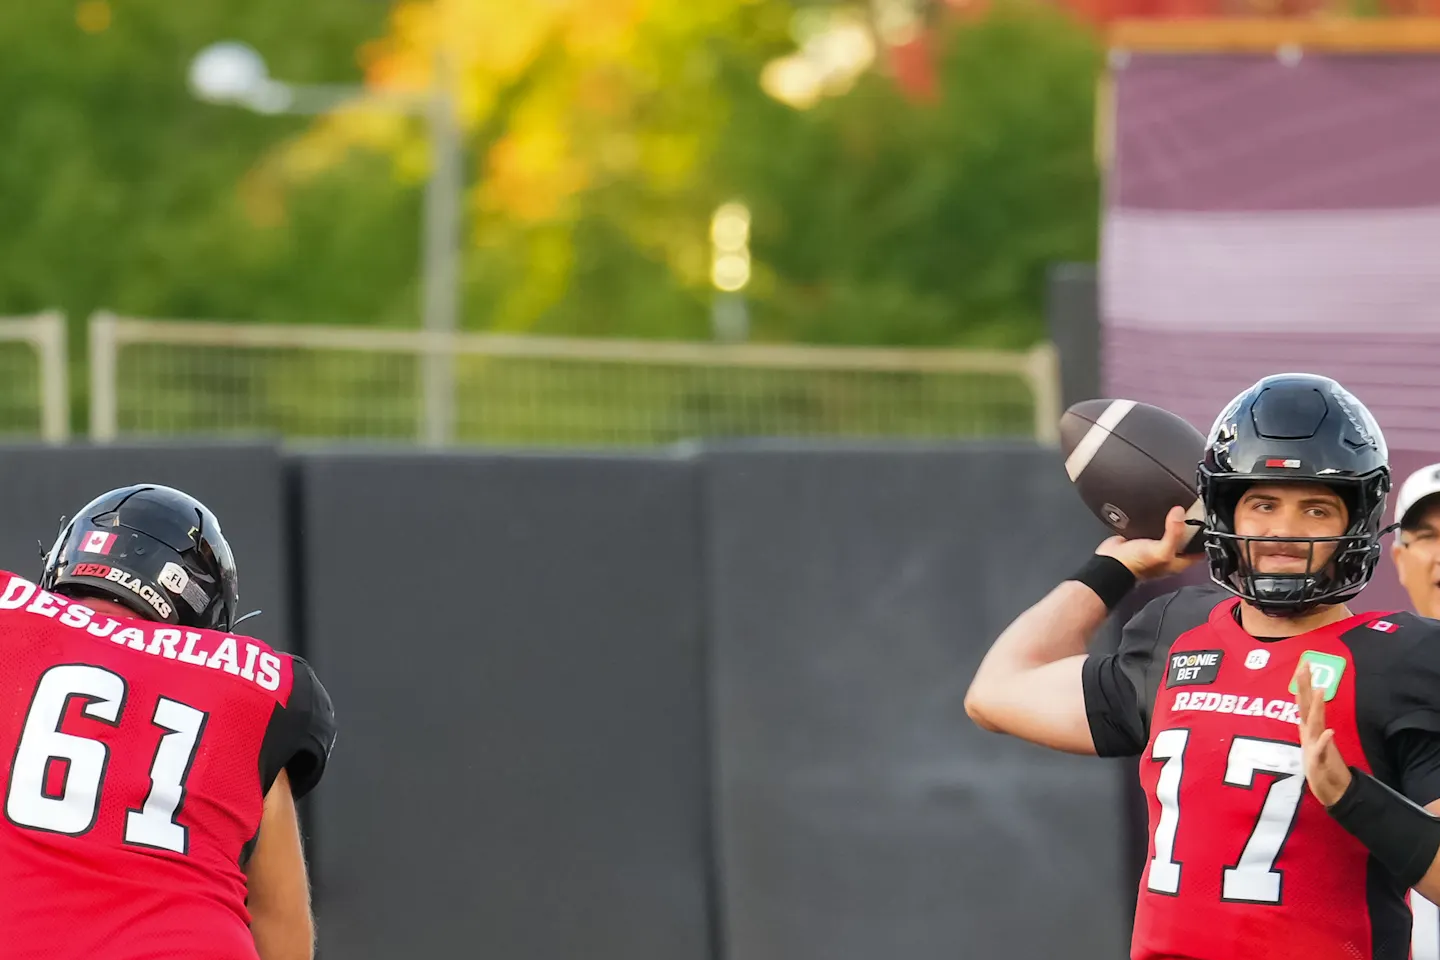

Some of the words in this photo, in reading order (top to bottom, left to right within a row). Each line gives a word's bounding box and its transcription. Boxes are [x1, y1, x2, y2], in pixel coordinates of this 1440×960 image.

[71, 563, 172, 619] REDBLACKS
[0, 576, 281, 691] DESJARLAIS
[1172, 653, 1218, 669] TOONIE
[1176, 667, 1201, 681] BET
[1172, 691, 1301, 725] REDBLACK
[3, 663, 210, 855] 61
[1147, 727, 1306, 906] 17
